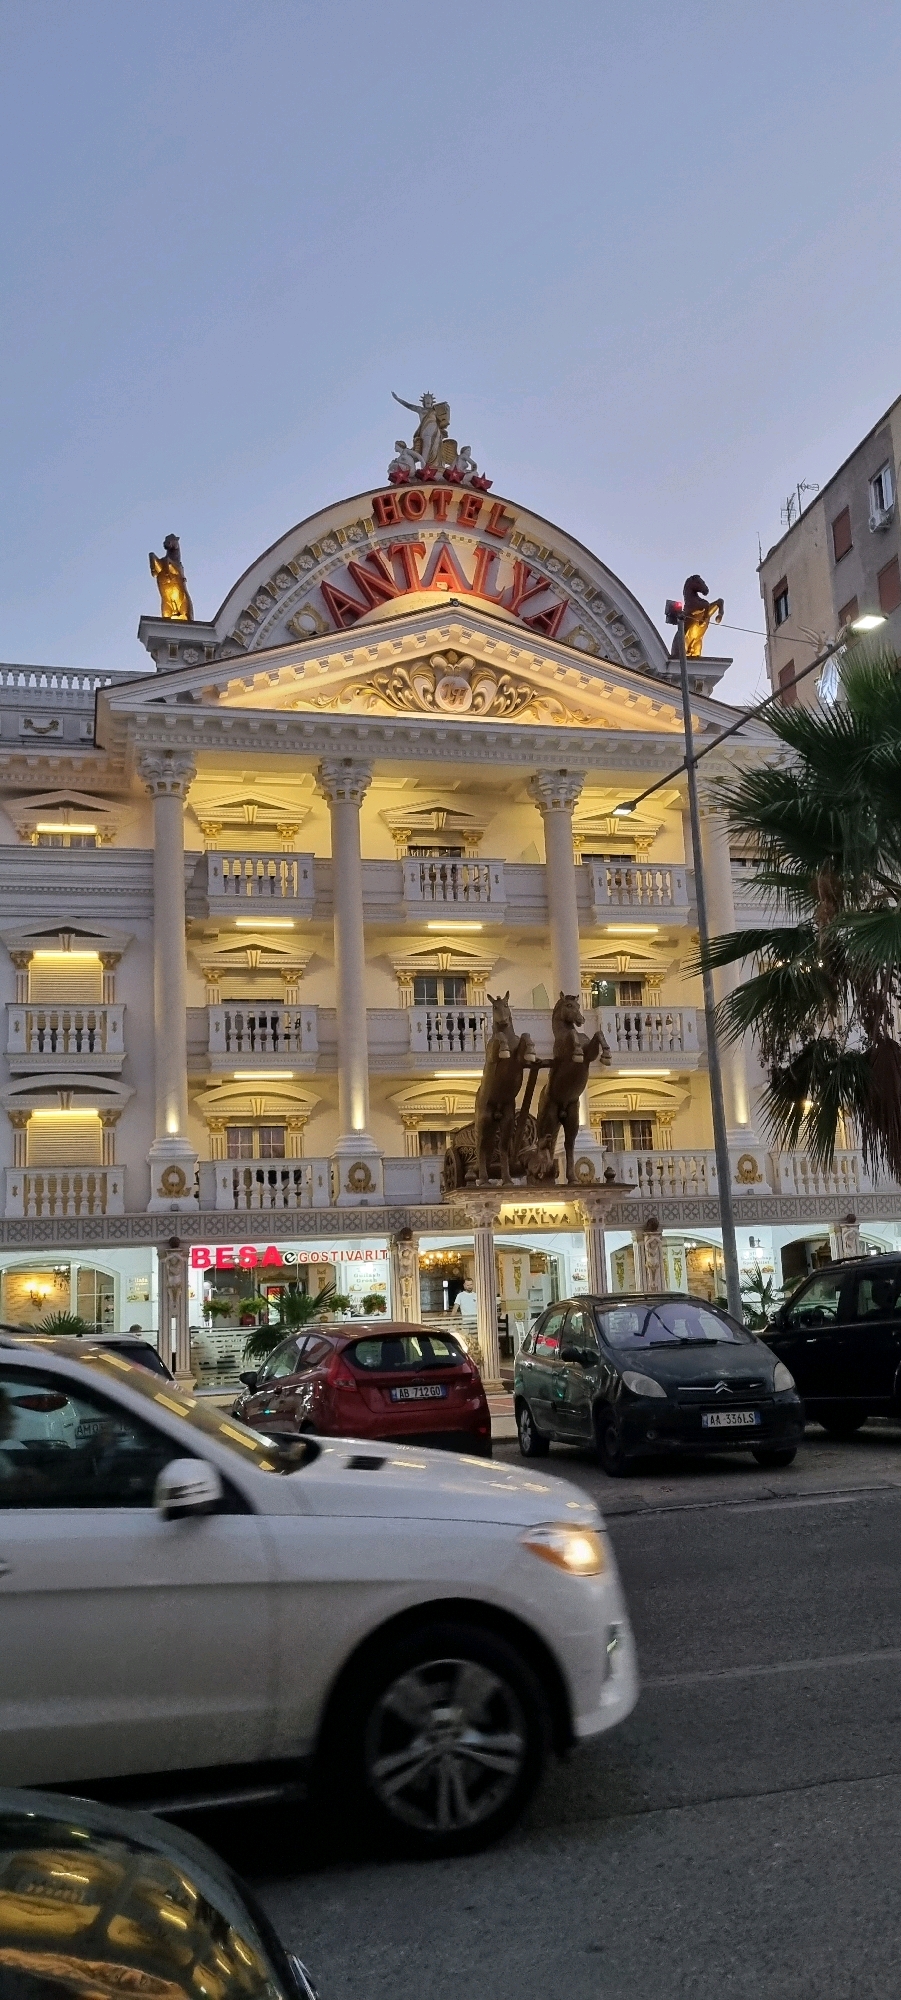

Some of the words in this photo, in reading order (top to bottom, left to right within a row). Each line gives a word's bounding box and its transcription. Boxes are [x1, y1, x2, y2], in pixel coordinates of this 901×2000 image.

[372, 489, 512, 538] HOTEL
[320, 541, 569, 638] ANTALYA
[191, 1246, 283, 1268] BESA
[297, 1249, 387, 1264] GOSTIVARIT
[399, 1388, 410, 1399] AB
